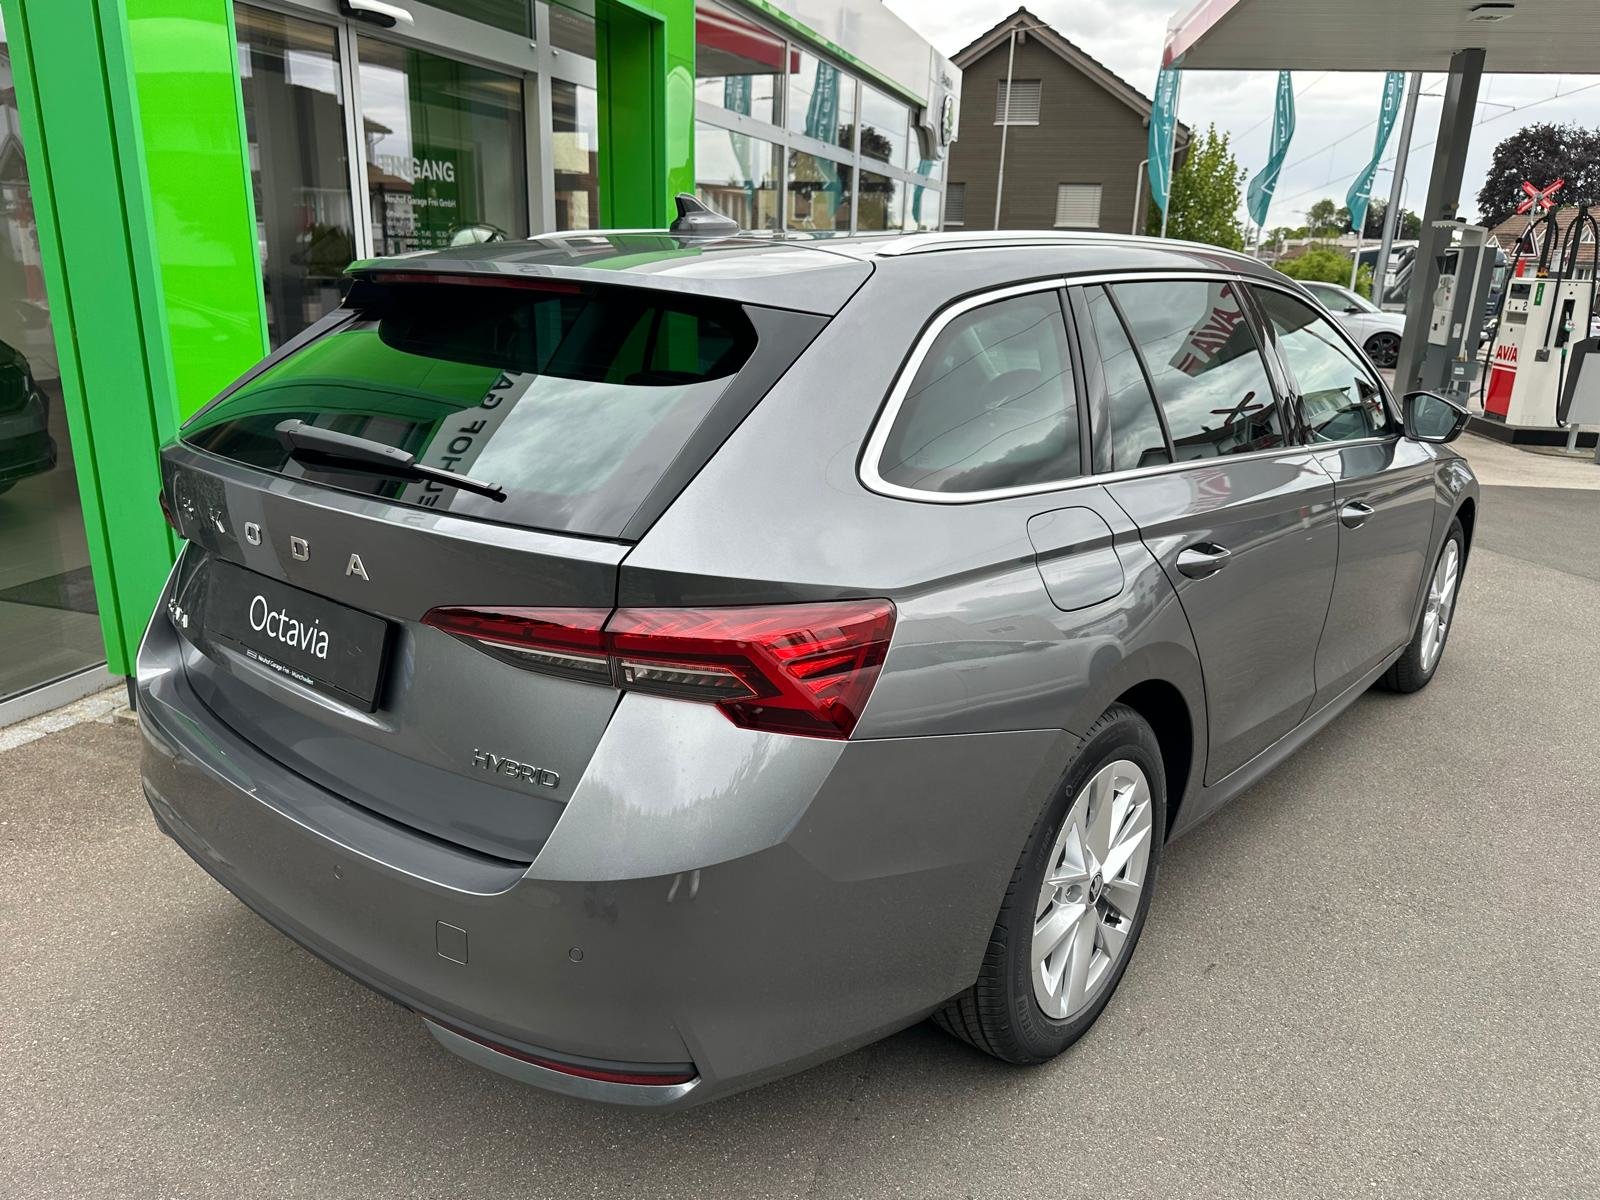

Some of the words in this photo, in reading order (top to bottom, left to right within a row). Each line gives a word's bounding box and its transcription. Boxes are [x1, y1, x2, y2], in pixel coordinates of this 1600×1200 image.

[1522, 301, 1528, 311] 2
[1495, 343, 1518, 362] AVIA
[249, 595, 329, 660] Octavia
[471, 748, 561, 789] HYBRID
